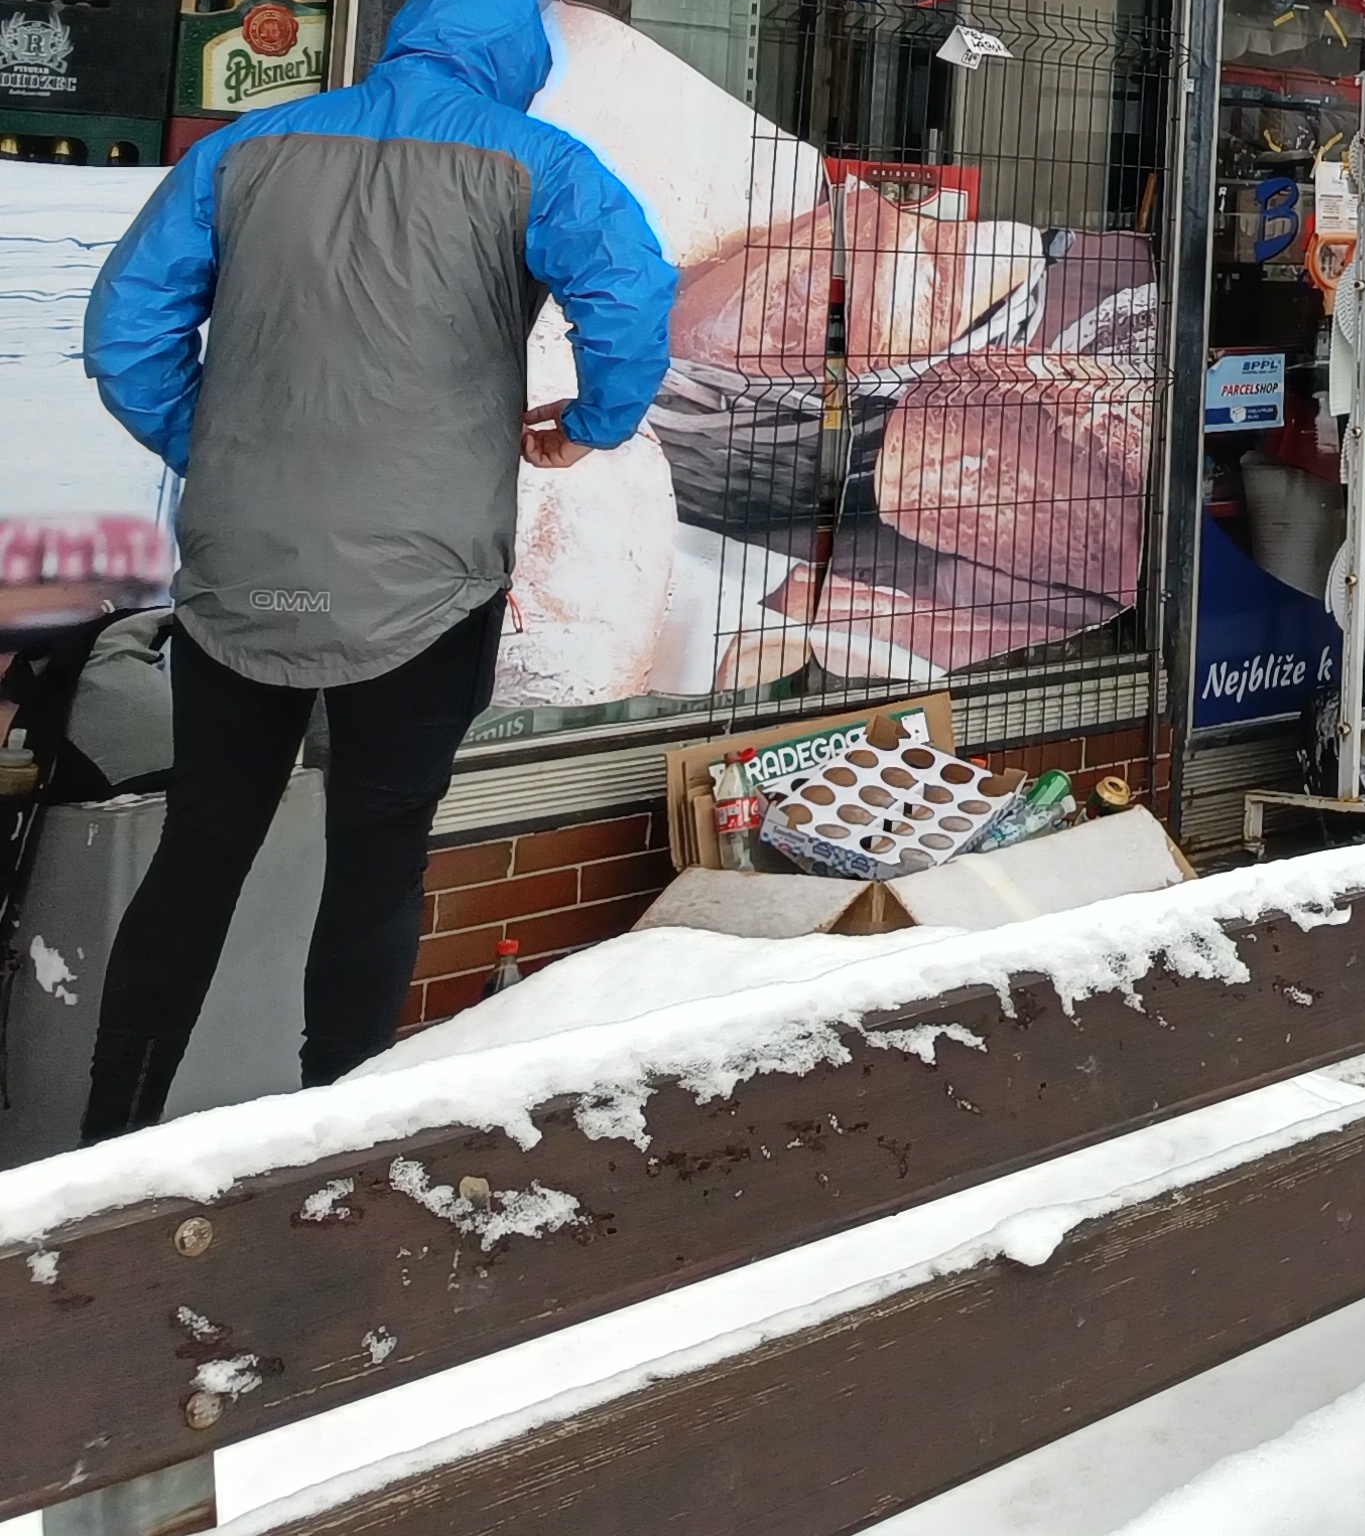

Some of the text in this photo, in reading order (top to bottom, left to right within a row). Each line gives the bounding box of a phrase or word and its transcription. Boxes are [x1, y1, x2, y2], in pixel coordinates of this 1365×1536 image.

[0, 72, 77, 92] OHOZEC
[224, 48, 305, 104] Pilsner
[1250, 360, 1279, 371] PPL
[1221, 382, 1279, 397] PARCELSHOP
[249, 589, 331, 612] OMM
[1201, 653, 1306, 703] Nejblíže
[1317, 645, 1333, 682] k
